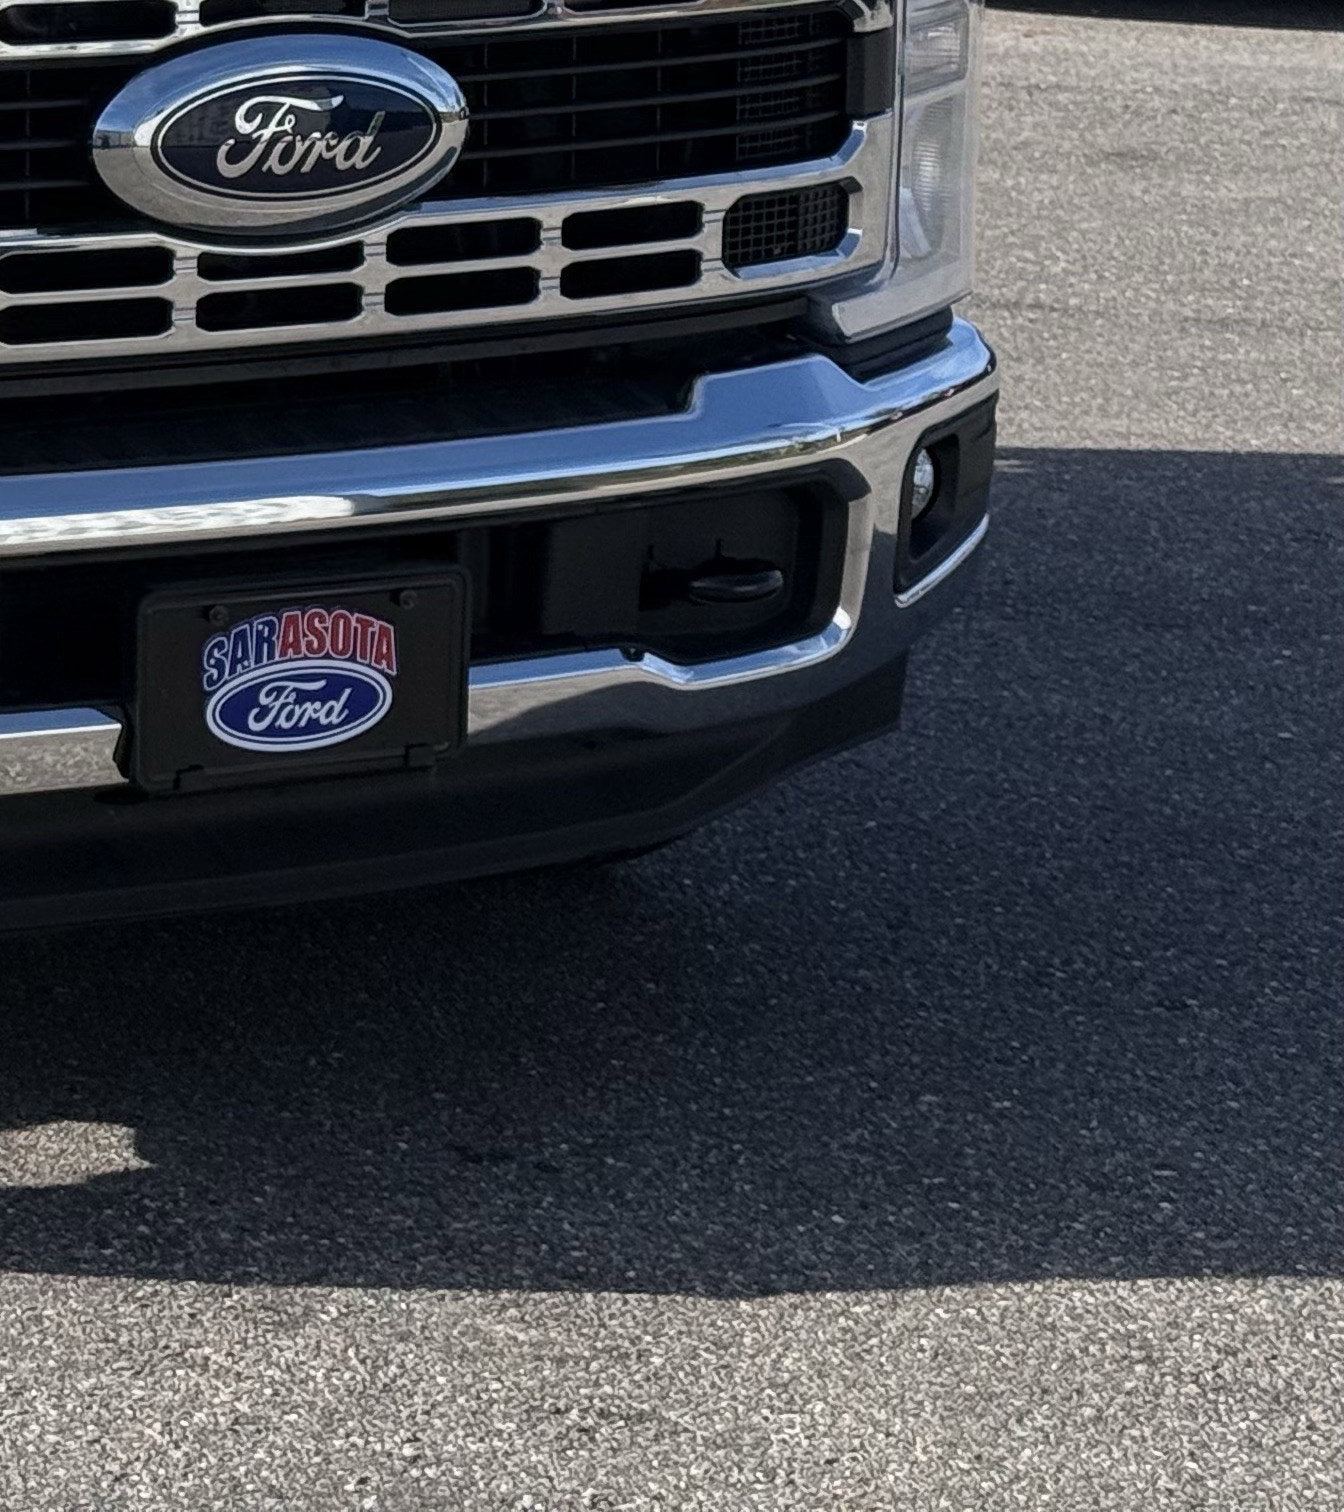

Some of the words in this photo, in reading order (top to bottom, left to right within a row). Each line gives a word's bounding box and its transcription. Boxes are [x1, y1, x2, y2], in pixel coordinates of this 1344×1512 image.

[215, 93, 389, 181] Ford
[202, 606, 399, 693] SARASOTA
[247, 678, 355, 733] Ford
